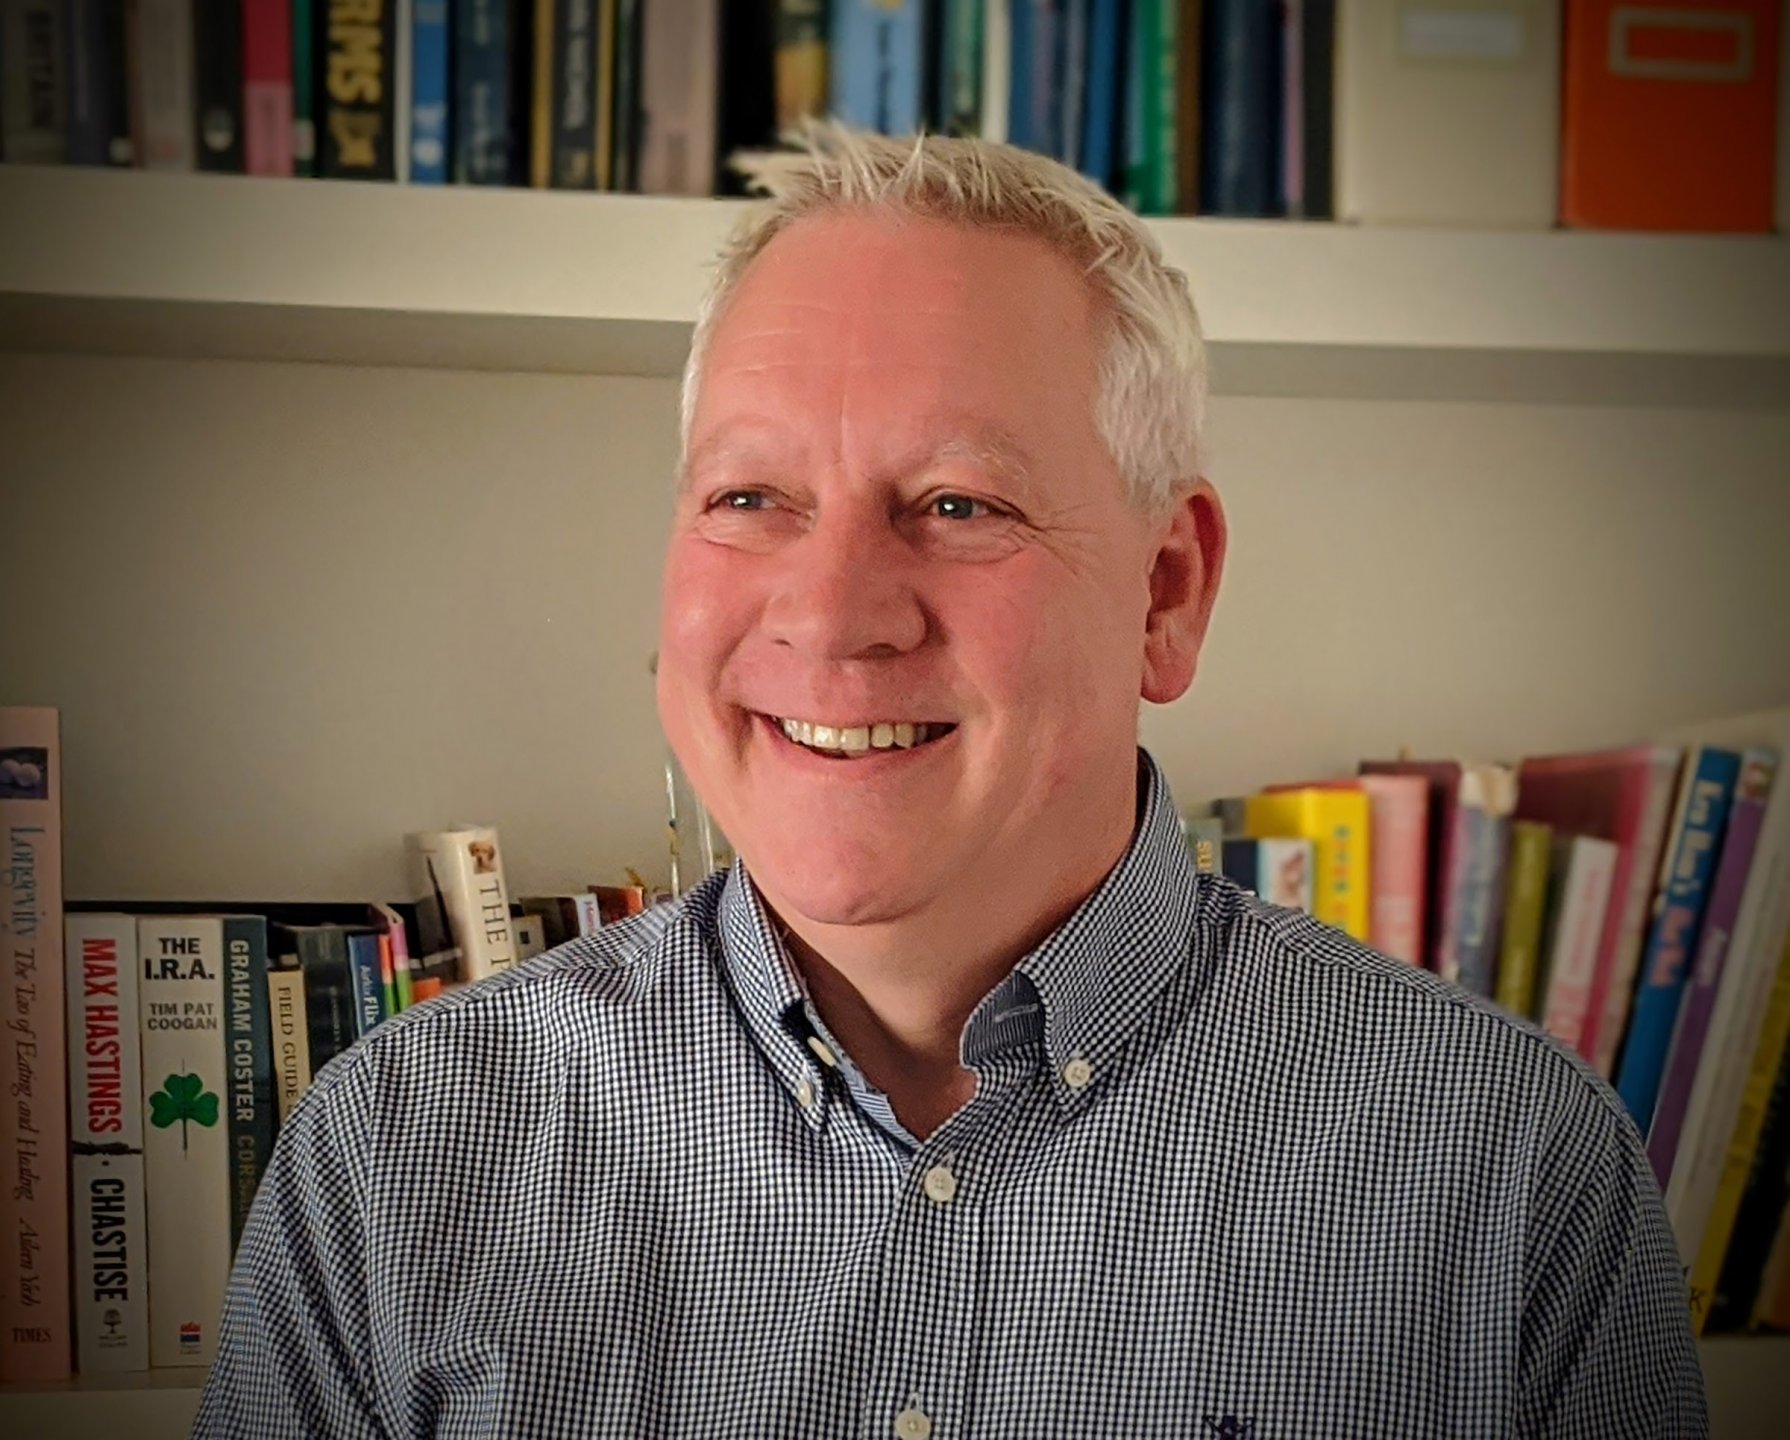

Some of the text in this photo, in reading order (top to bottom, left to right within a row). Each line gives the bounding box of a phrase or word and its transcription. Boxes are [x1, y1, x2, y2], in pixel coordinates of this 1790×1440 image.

[479, 879, 508, 945] THE
[144, 958, 216, 980] I.R.A.
[158, 937, 201, 954] THE
[3, 827, 45, 1201] Longevity The Tao of Eating and Healing
[150, 1002, 215, 1016] TIM PAT
[229, 939, 252, 1032] GRAHAM
[278, 986, 294, 1036] FIELD
[82, 938, 122, 1134] MAX HASTINGS
[147, 1017, 218, 1031] COOGAN
[233, 1038, 255, 1122] COSTER
[282, 1042, 298, 1099] GUIDE
[90, 1177, 129, 1303] CHASTISE
[12, 1327, 52, 1344] TIMES
